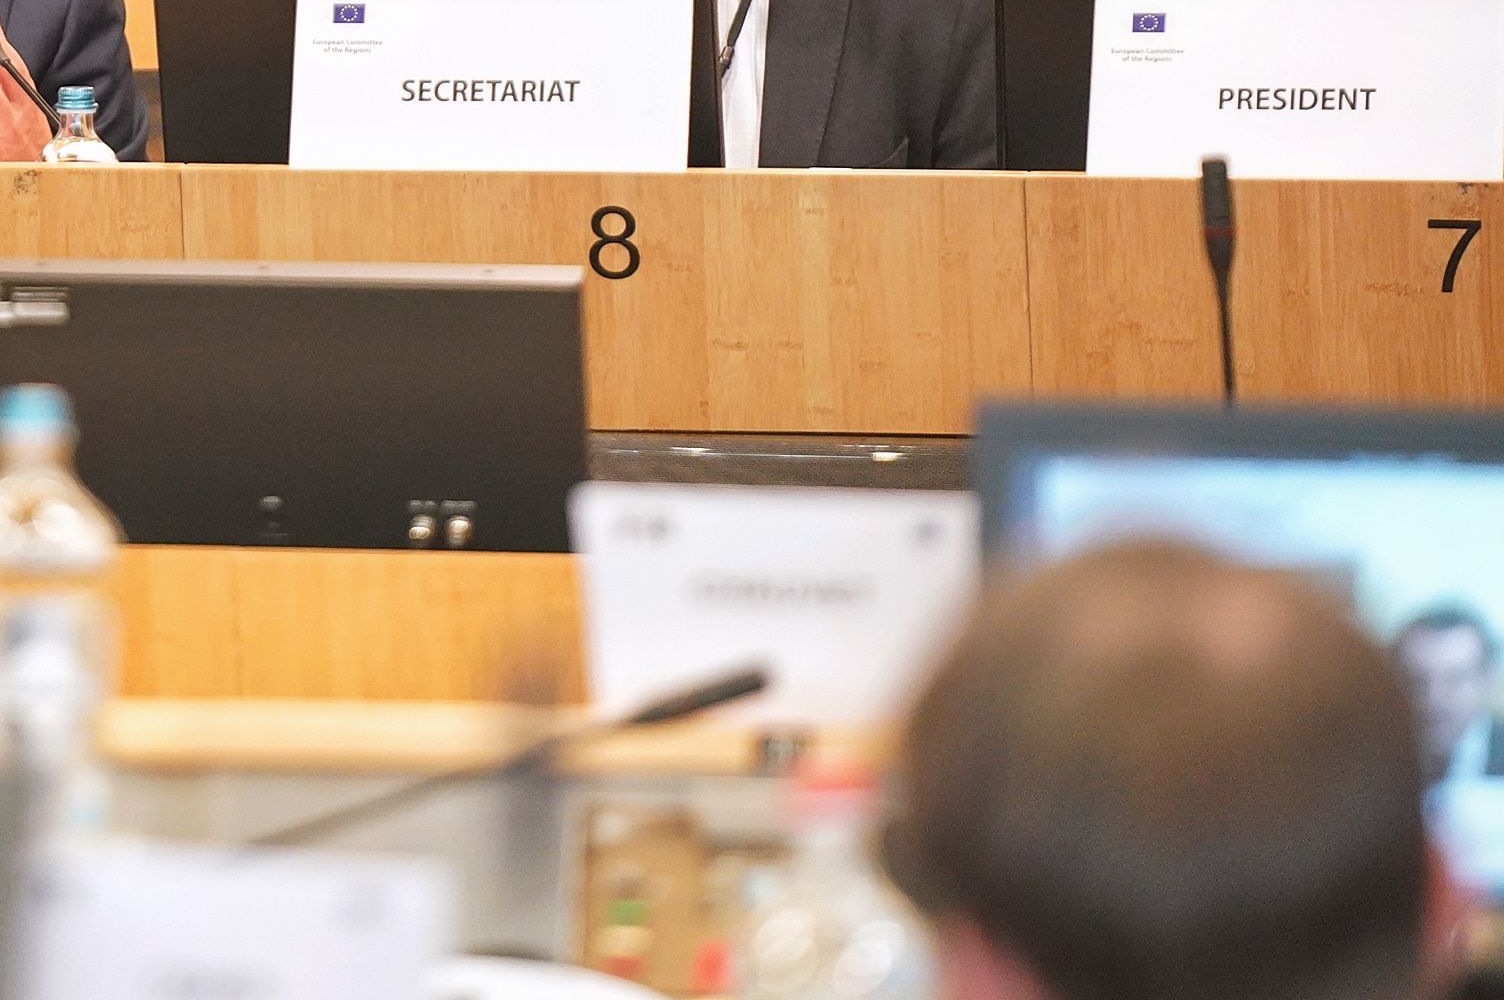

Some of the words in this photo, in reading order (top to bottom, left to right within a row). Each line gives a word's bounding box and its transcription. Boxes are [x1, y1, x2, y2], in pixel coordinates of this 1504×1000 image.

[402, 80, 580, 102] SECRETARIAT
[1218, 88, 1377, 111] PRESIDENT
[588, 205, 641, 280] 8
[1427, 219, 1482, 293] 7
